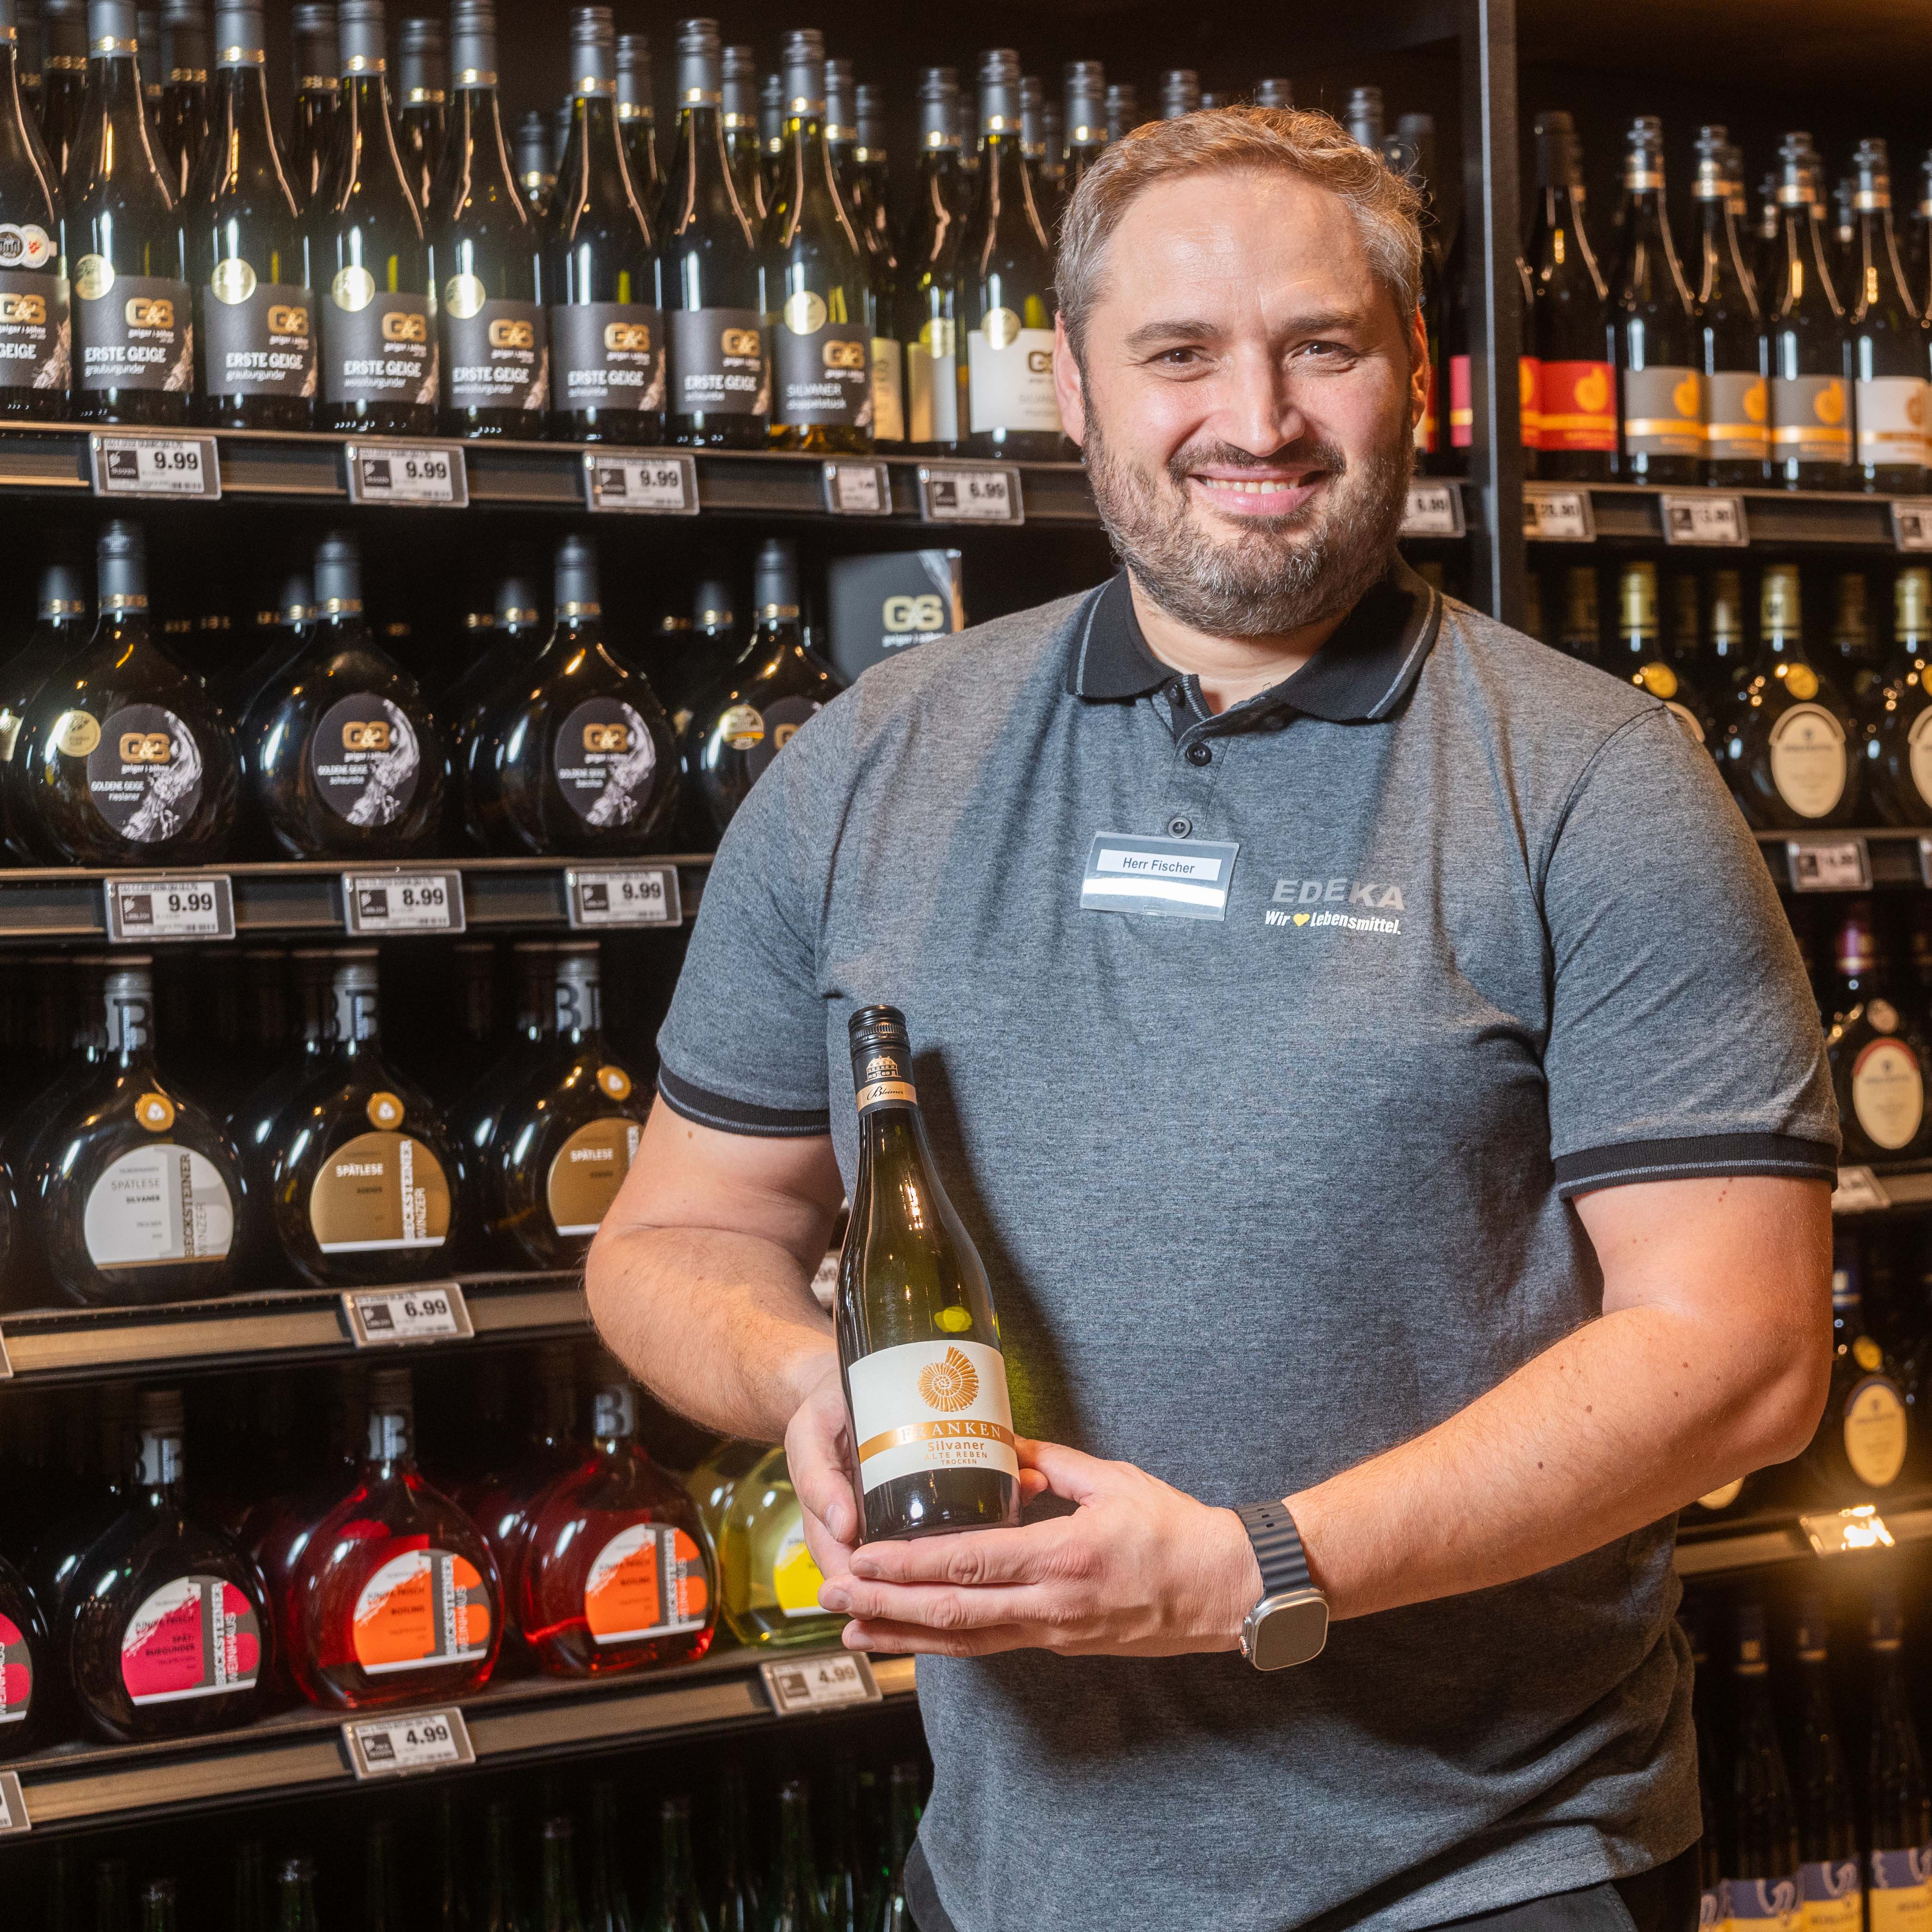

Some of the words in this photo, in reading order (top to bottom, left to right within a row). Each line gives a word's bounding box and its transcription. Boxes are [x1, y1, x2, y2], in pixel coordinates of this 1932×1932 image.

[0, 343, 36, 360] GEIGE
[85, 347, 125, 363] ERSTE
[127, 347, 166, 363] GEIGE
[225, 352, 267, 368] ERSTE
[269, 352, 303, 369] GEIGE
[344, 360, 384, 375] ERSTE
[386, 360, 421, 377] GEIGE
[85, 364, 145, 377] grauburgunder
[226, 369, 286, 382] grauburgunder
[453, 367, 492, 382] ERSTE
[494, 367, 529, 383] GEIGE
[568, 370, 607, 386] ERSTE
[608, 370, 644, 387] GEIGE
[684, 375, 724, 390] ERSTE
[725, 375, 757, 392] GEIGE
[787, 383, 842, 397] SILVANER
[154, 451, 198, 470] 9.99
[406, 462, 447, 479] 9.99
[640, 470, 679, 488] 9.99
[969, 482, 1005, 499] 6.99
[91, 781, 123, 792] GOLDENE
[124, 781, 144, 791] GEIGE
[1122, 856, 1147, 869] Herr
[1151, 860, 1195, 874] Fischer
[402, 888, 444, 907] 8.99
[622, 883, 661, 899] 9.99
[1271, 878, 1405, 910] EDEKA
[169, 893, 213, 912] 9.99
[1265, 910, 1291, 927] Wir
[570, 1148, 614, 1163] SPÄTLESE
[336, 1163, 383, 1178] SPÄTLESE
[111, 1177, 160, 1191] SPÄTLESE
[400, 1139, 415, 1241] BECKSTEINER
[180, 1153, 194, 1258] BECKSTEINER
[415, 1187, 427, 1240] WINZER
[195, 1202, 208, 1257] WINZER
[405, 1299, 448, 1318] 6.99
[901, 1422, 1001, 1441] FRANKEN
[925, 1452, 951, 1460] ALTE
[956, 1451, 988, 1460] REBEN
[927, 1441, 985, 1453] Silvaner
[442, 1554, 458, 1656] BECKSTEINER
[211, 1581, 227, 1686] BECKSTEINER
[225, 1612, 238, 1683] WEINHAUS
[818, 1665, 856, 1684] 4.99
[405, 1723, 448, 1747] 4.99
